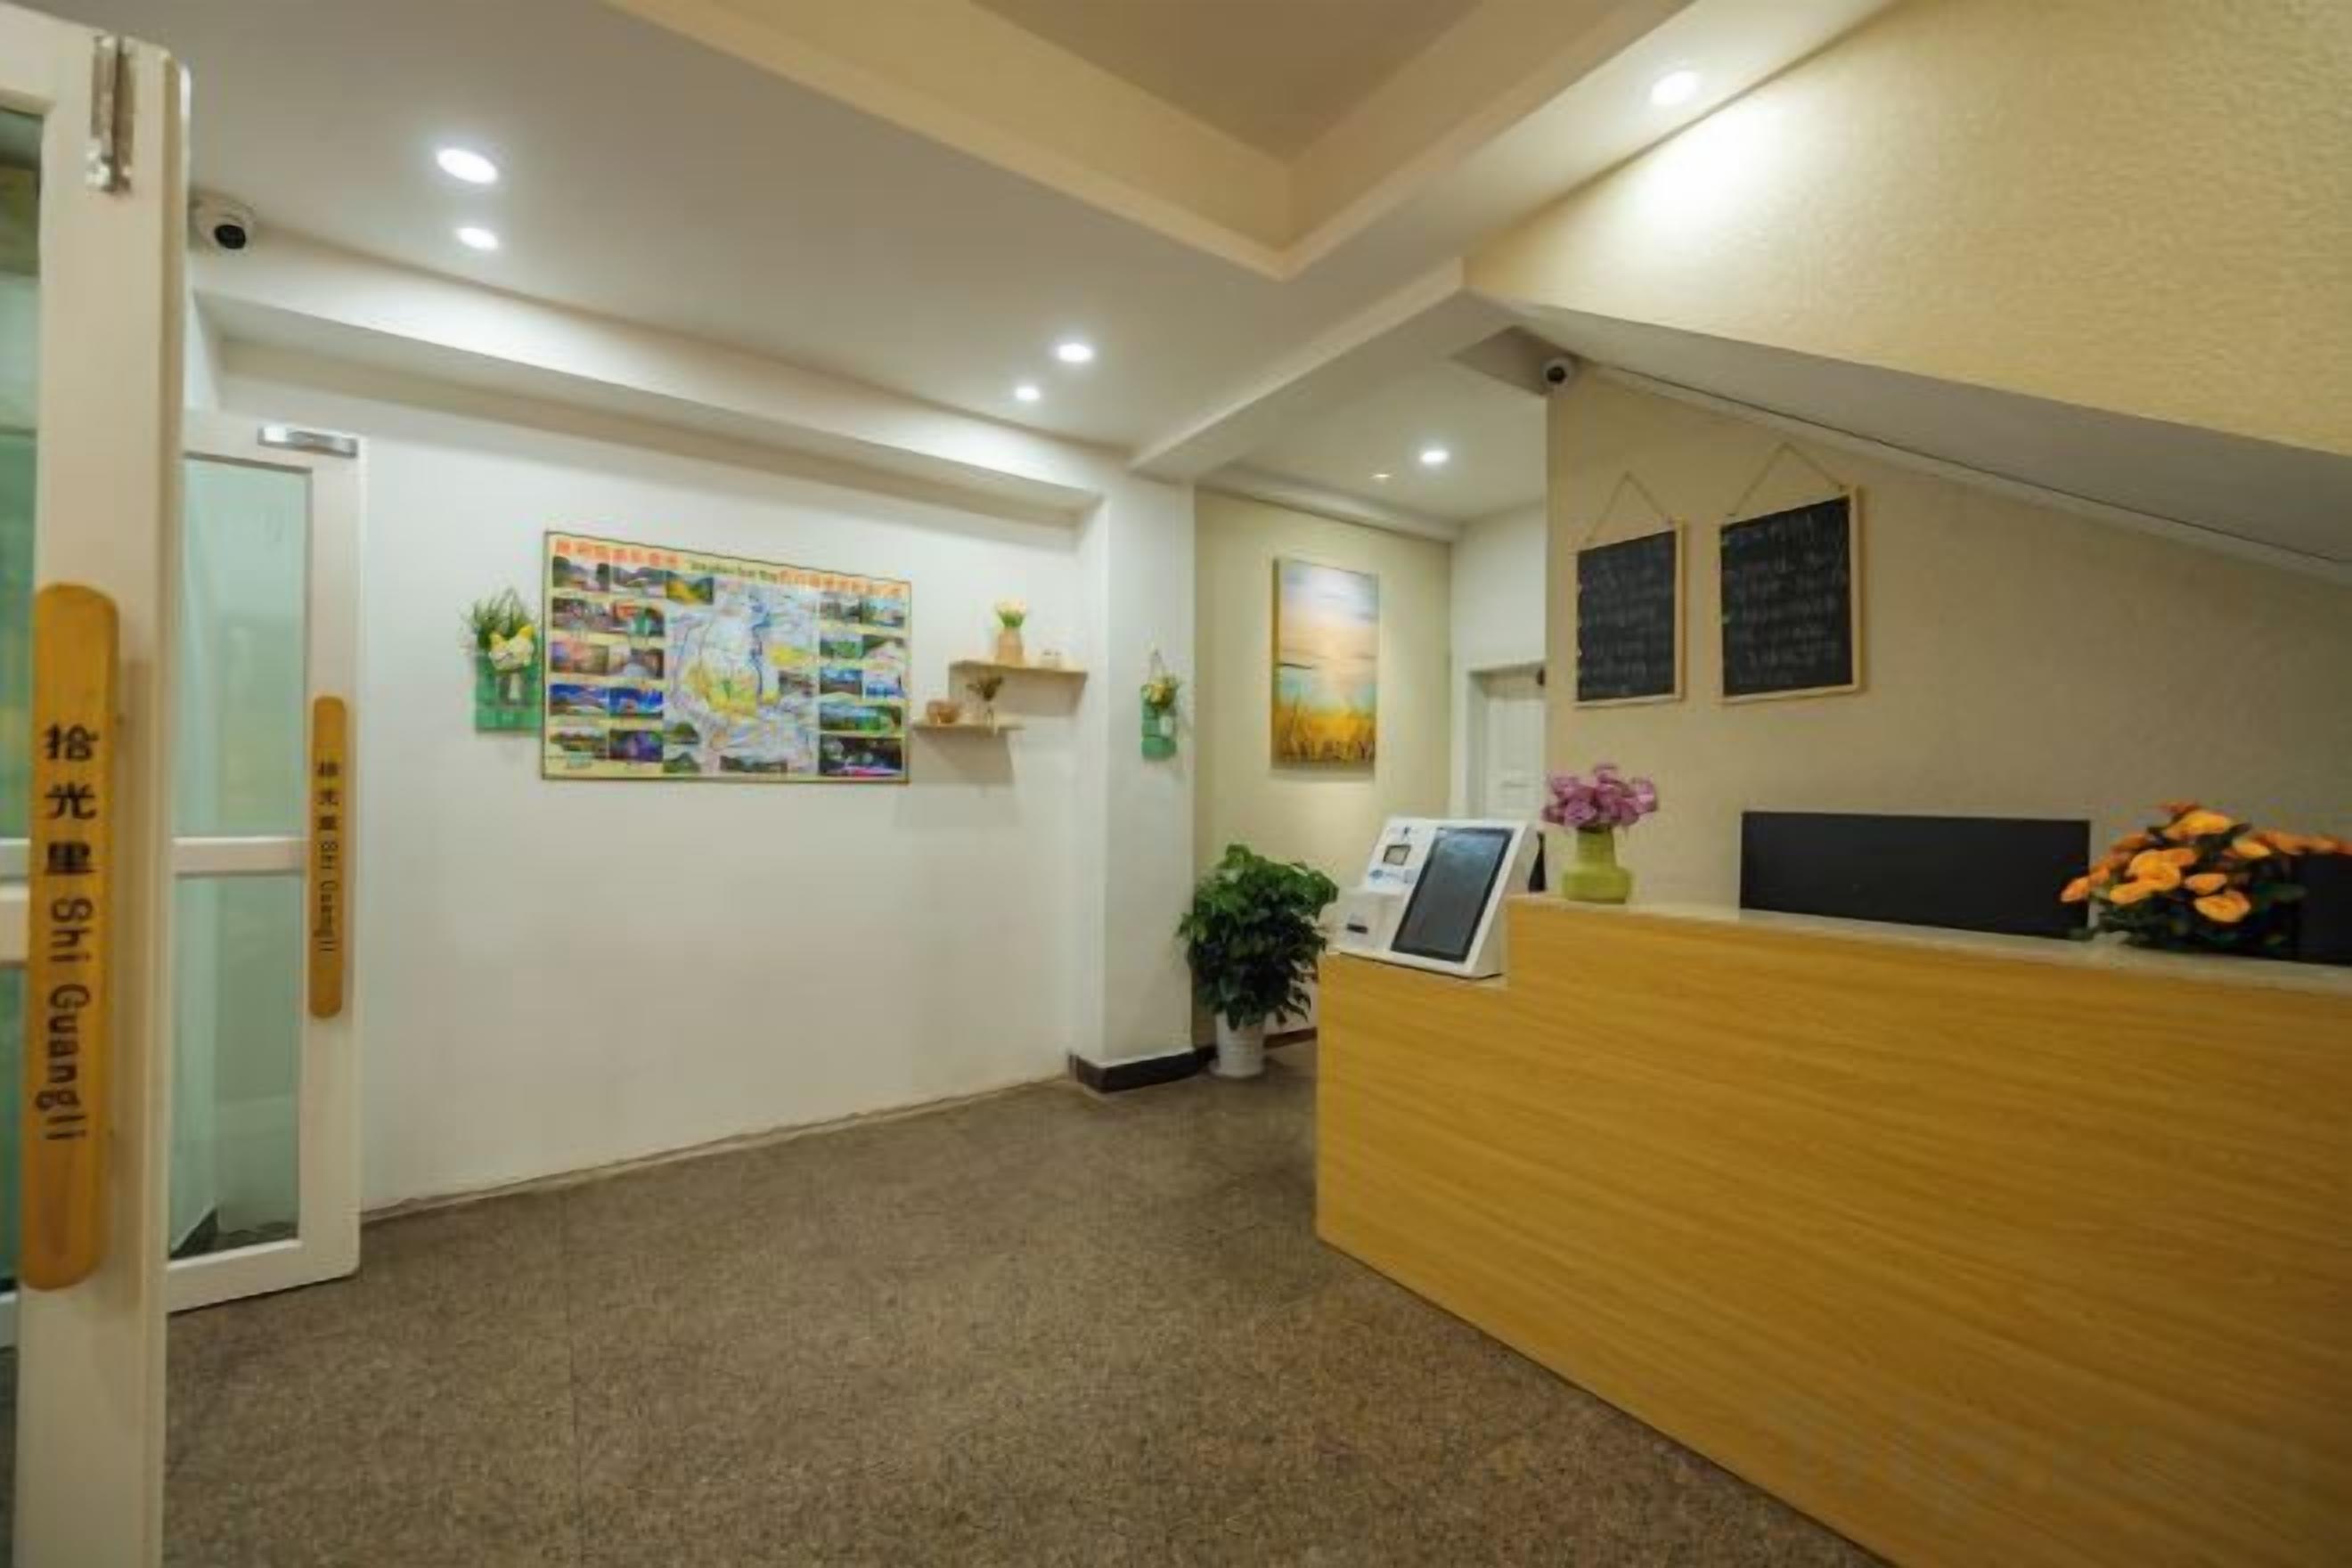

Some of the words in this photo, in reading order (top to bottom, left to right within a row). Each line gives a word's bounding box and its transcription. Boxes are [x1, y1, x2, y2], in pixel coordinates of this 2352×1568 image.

[44, 723, 98, 876] 拾光里
[48, 896, 93, 963] Shi
